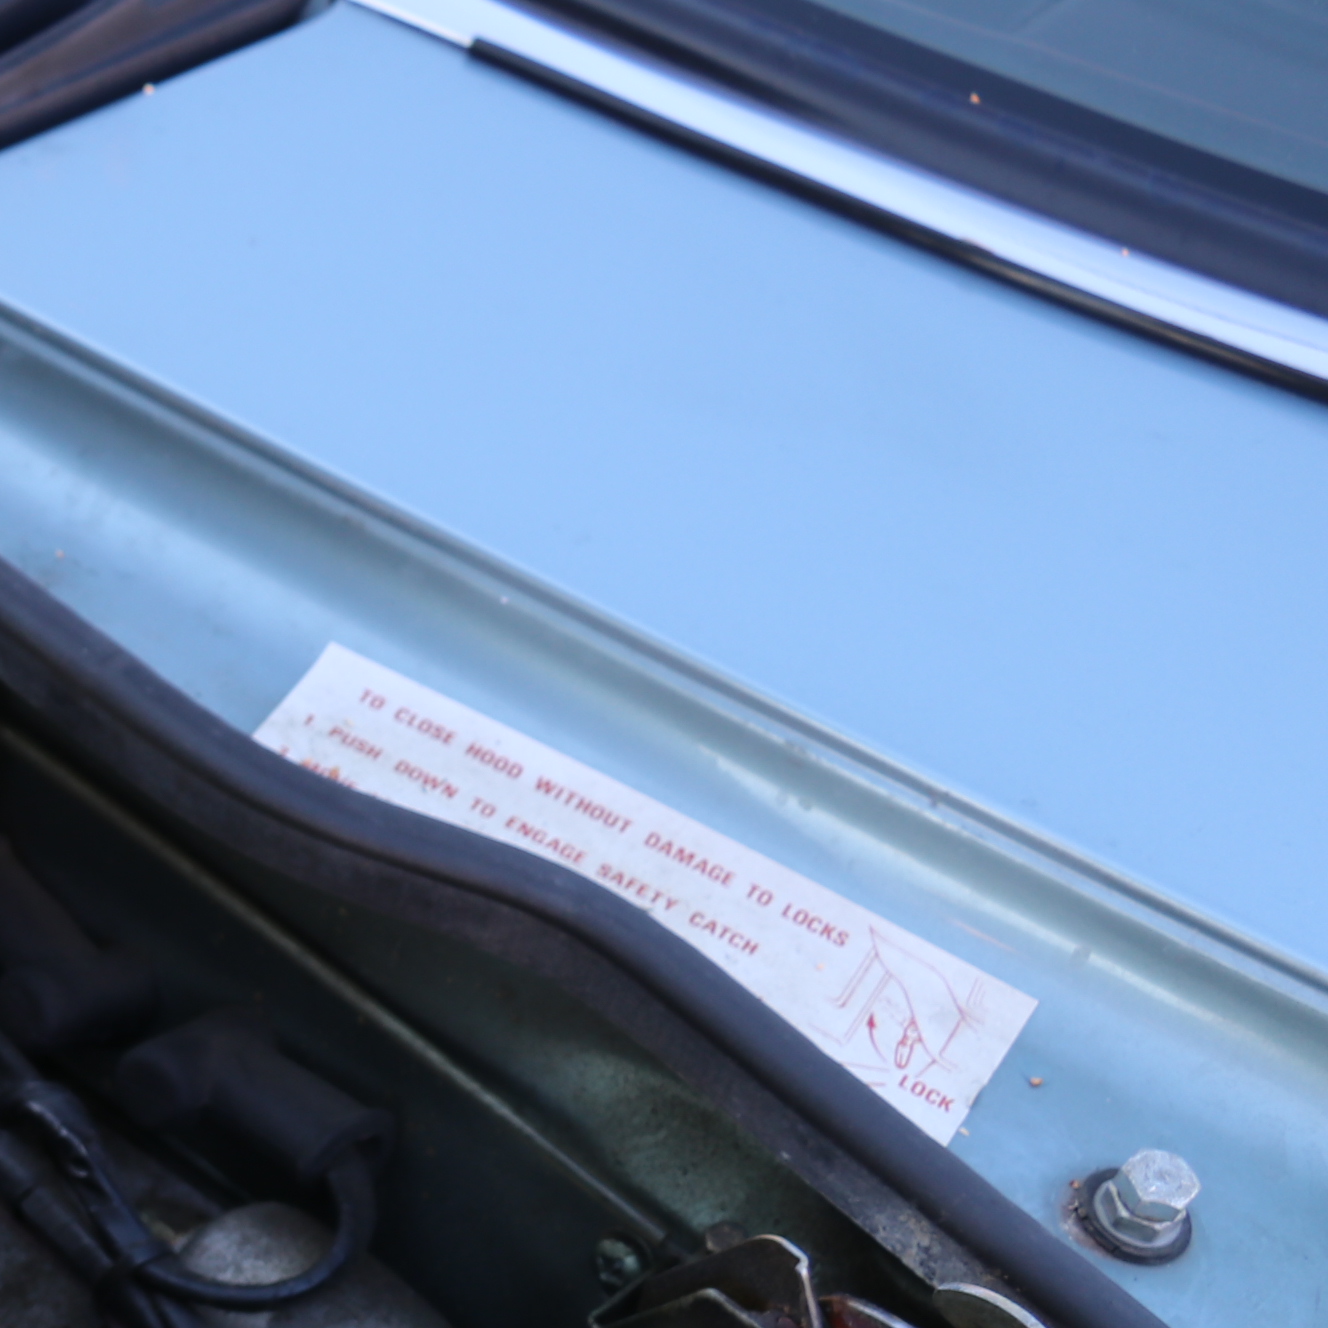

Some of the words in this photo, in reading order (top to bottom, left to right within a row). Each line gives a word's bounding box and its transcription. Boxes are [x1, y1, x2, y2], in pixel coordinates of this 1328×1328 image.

[328, 726, 383, 760] PUSH
[395, 759, 459, 798] DOWN
[470, 797, 497, 818] TO
[504, 815, 587, 865] ENGAGE
[597, 863, 679, 911] SAFETY
[688, 911, 759, 955] CATCH
[359, 688, 385, 710] TO
[394, 706, 455, 744] CLOSE
[465, 741, 523, 779] HOOD
[534, 776, 633, 833] WITHOUT
[644, 832, 736, 886] DAMAGE
[746, 883, 774, 906] TO
[781, 903, 850, 947] LOCKS
[898, 1074, 955, 1113] LOCK
